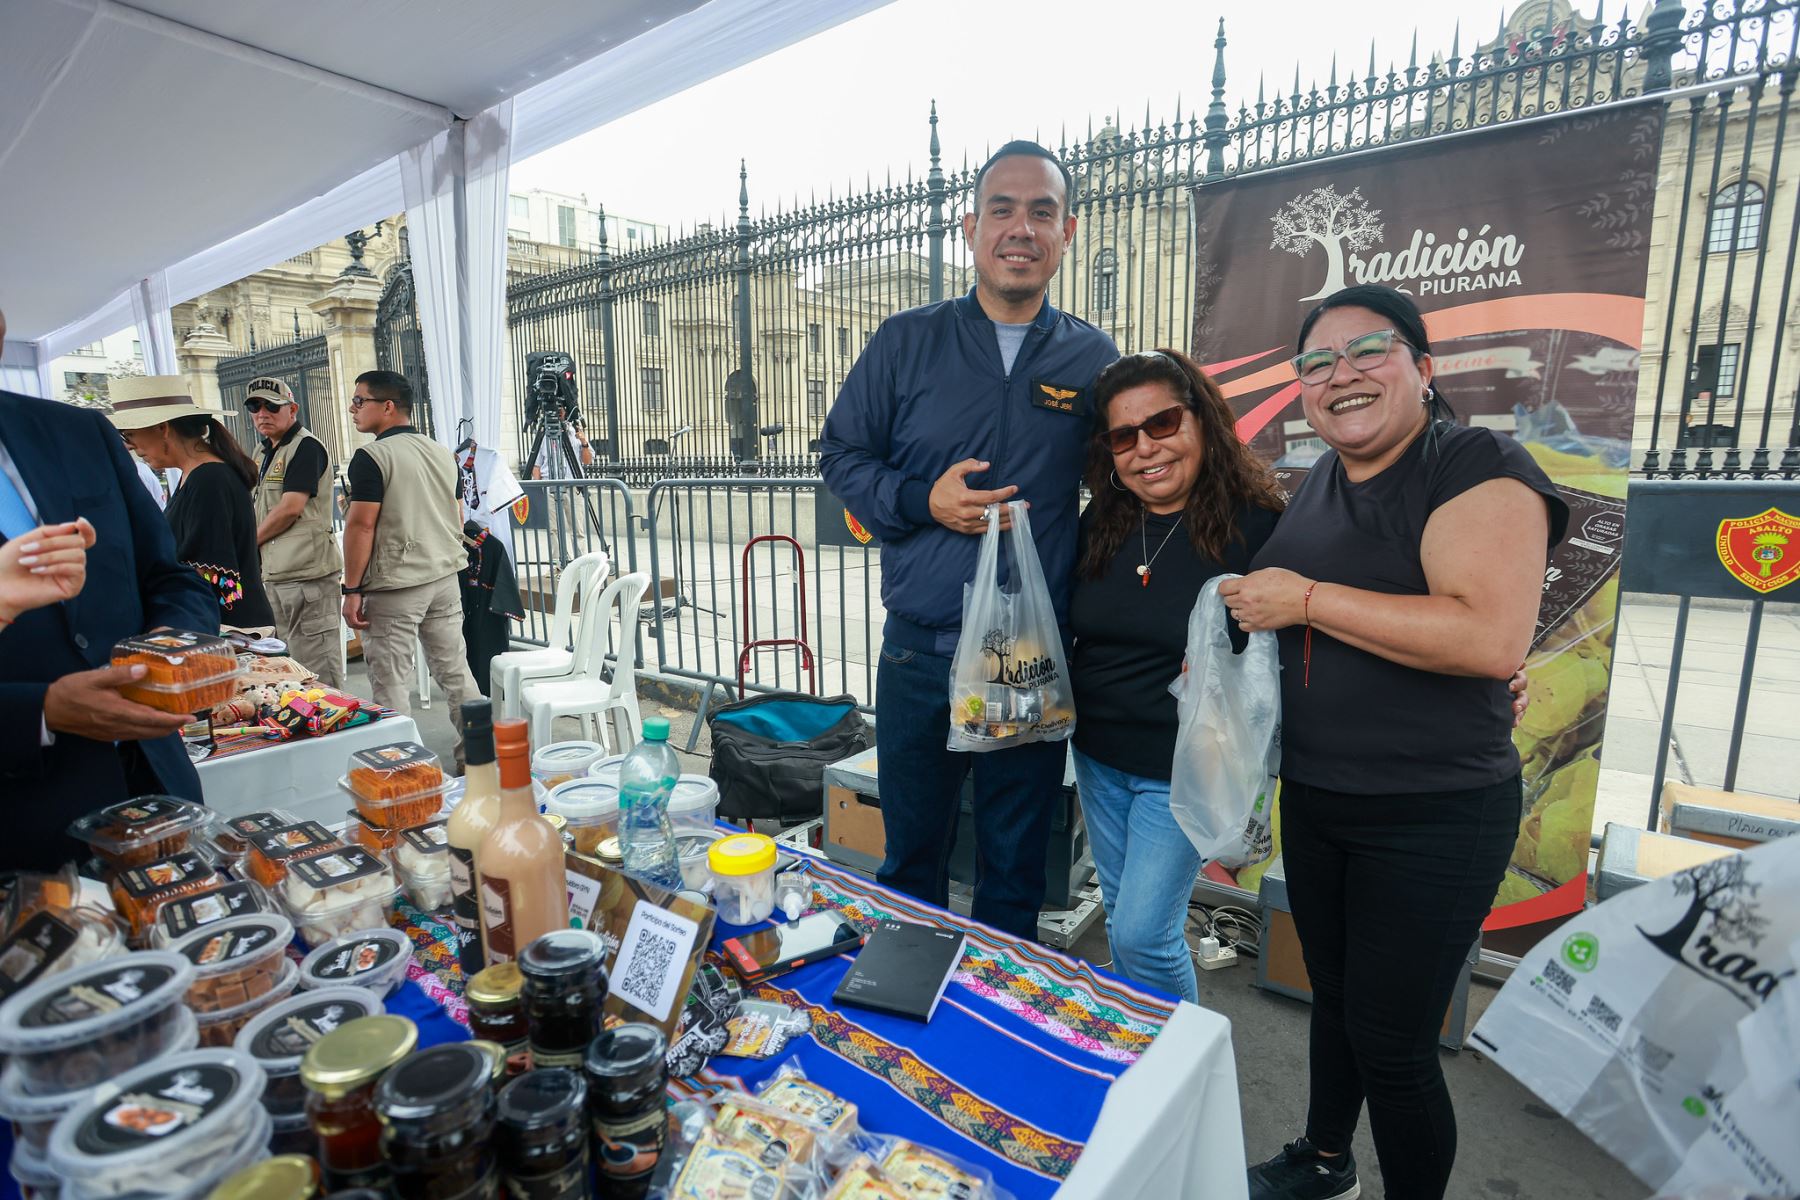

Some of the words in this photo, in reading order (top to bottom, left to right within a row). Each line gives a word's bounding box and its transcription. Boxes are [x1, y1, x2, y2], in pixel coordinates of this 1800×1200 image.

[1419, 269, 1522, 296] PIURANA
[248, 379, 281, 395] POLICIA
[1749, 525, 1793, 535] ASALTO
[1719, 535, 1734, 566] UNIDAD
[1739, 572, 1789, 589] SERVICIOS
